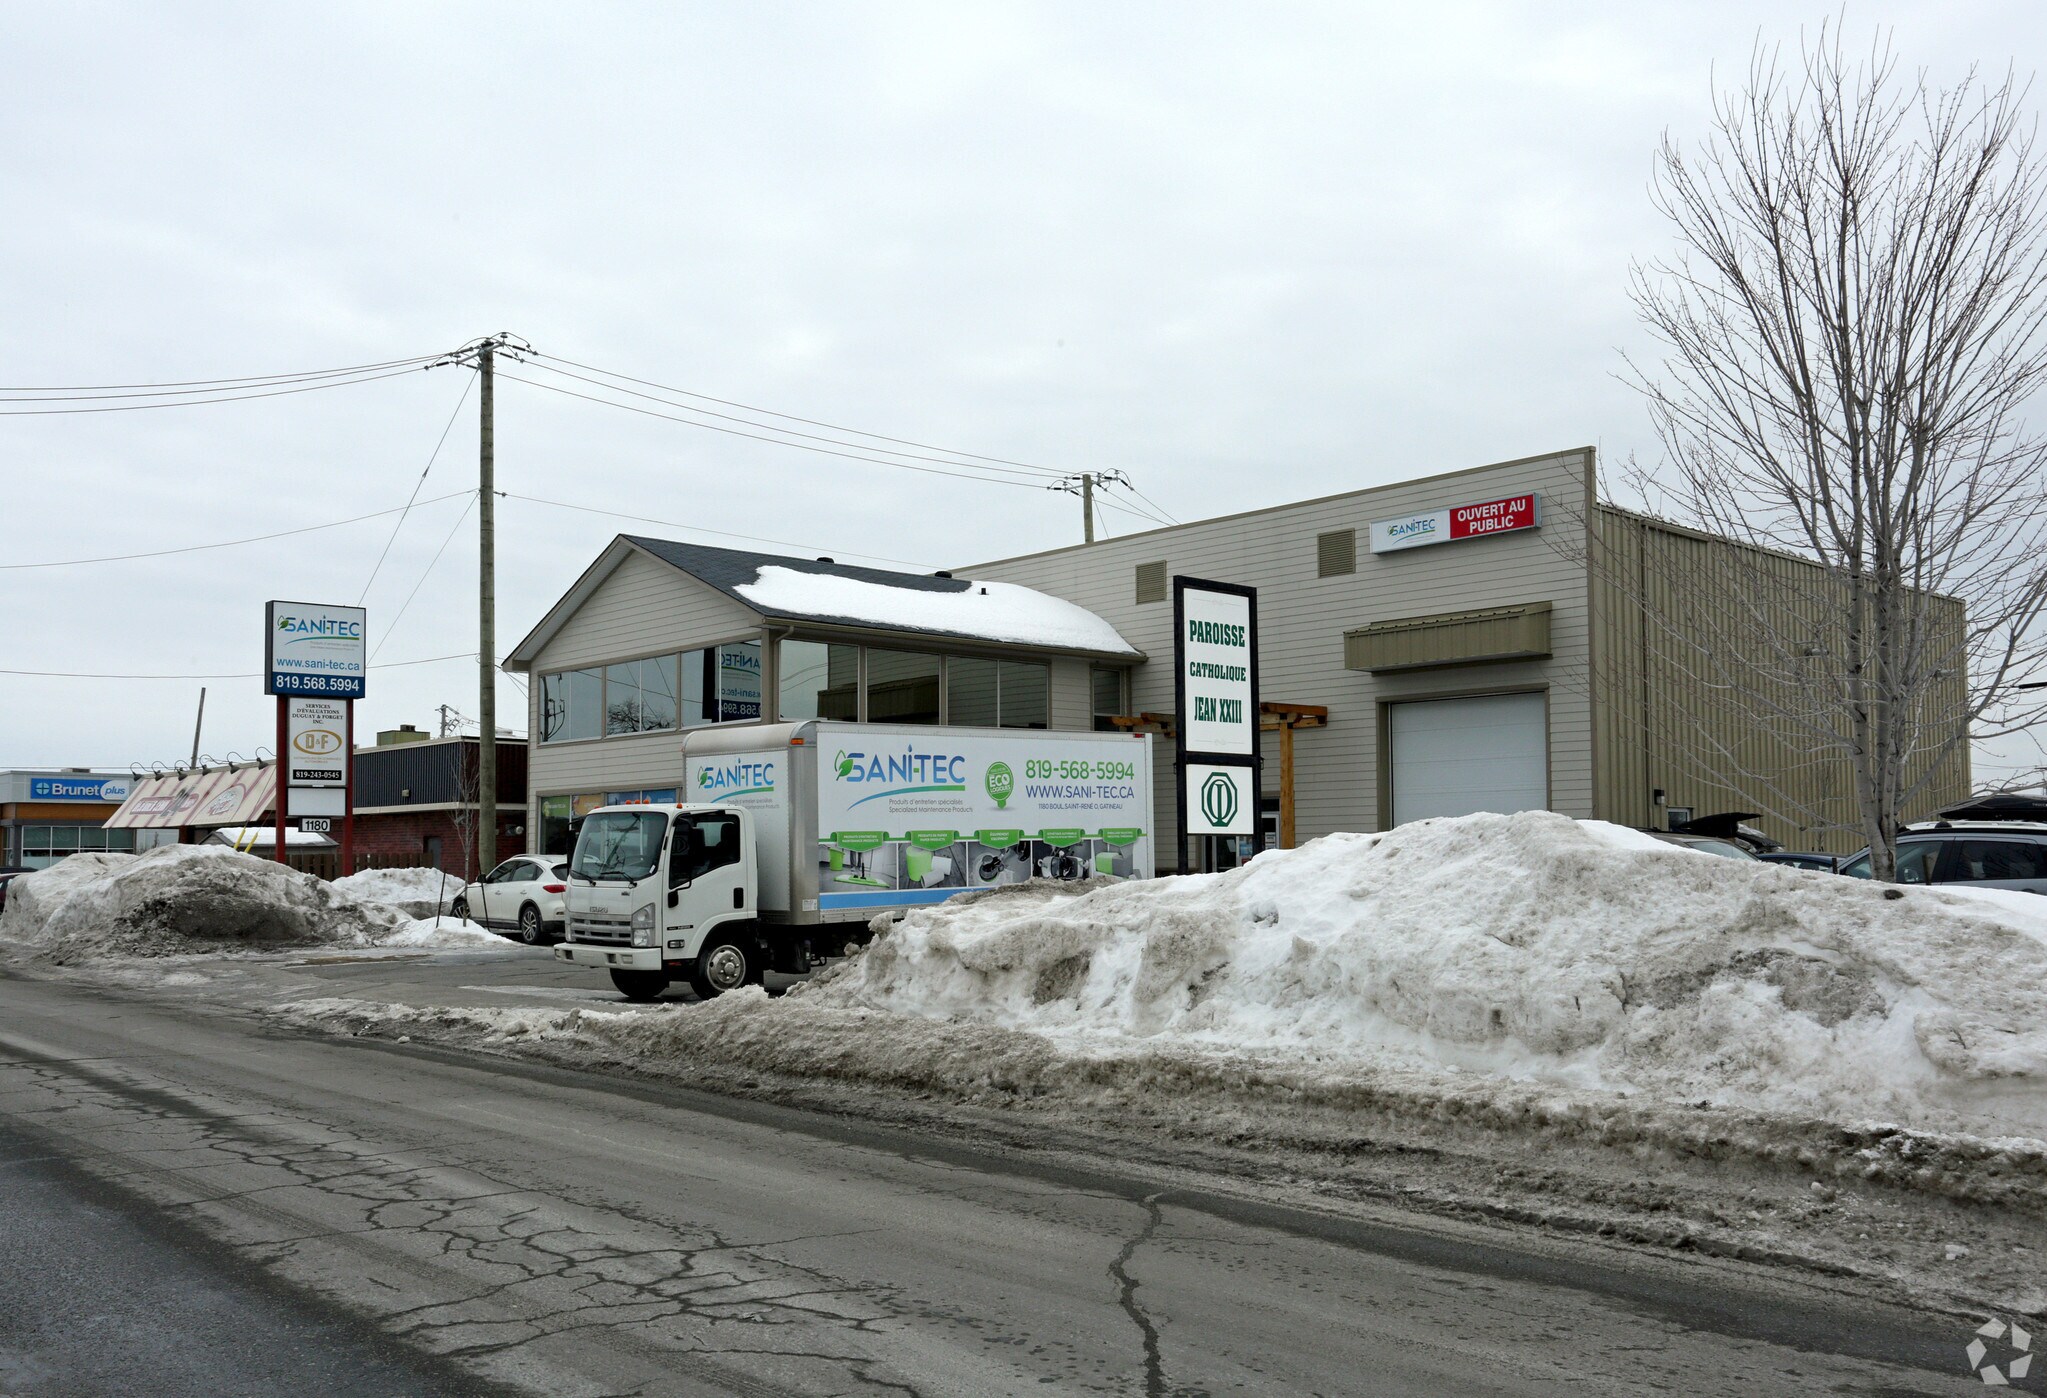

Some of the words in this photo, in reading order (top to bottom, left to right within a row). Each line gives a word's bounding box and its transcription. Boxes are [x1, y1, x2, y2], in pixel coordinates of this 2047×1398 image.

[1457, 503, 1505, 521] OUVERT
[1509, 499, 1526, 513] AU
[1469, 515, 1514, 533] PUBLIC
[1189, 620, 1246, 647] PAROISSE
[276, 658, 360, 671] www.sani-tec.ca
[1189, 661, 1247, 682] CATHOLIQUE
[276, 675, 360, 691] 819.568.5994
[1194, 696, 1217, 722] JEAN
[1219, 698, 1242, 723] XXIII
[1025, 759, 1135, 780] 819-568-5994
[988, 773, 1011, 787] ECO
[52, 783, 99, 796] Brunet
[104, 785, 126, 795] plus
[1025, 785, 1135, 799] WWW.SANI-TEC.CA
[305, 820, 328, 830] 1180
